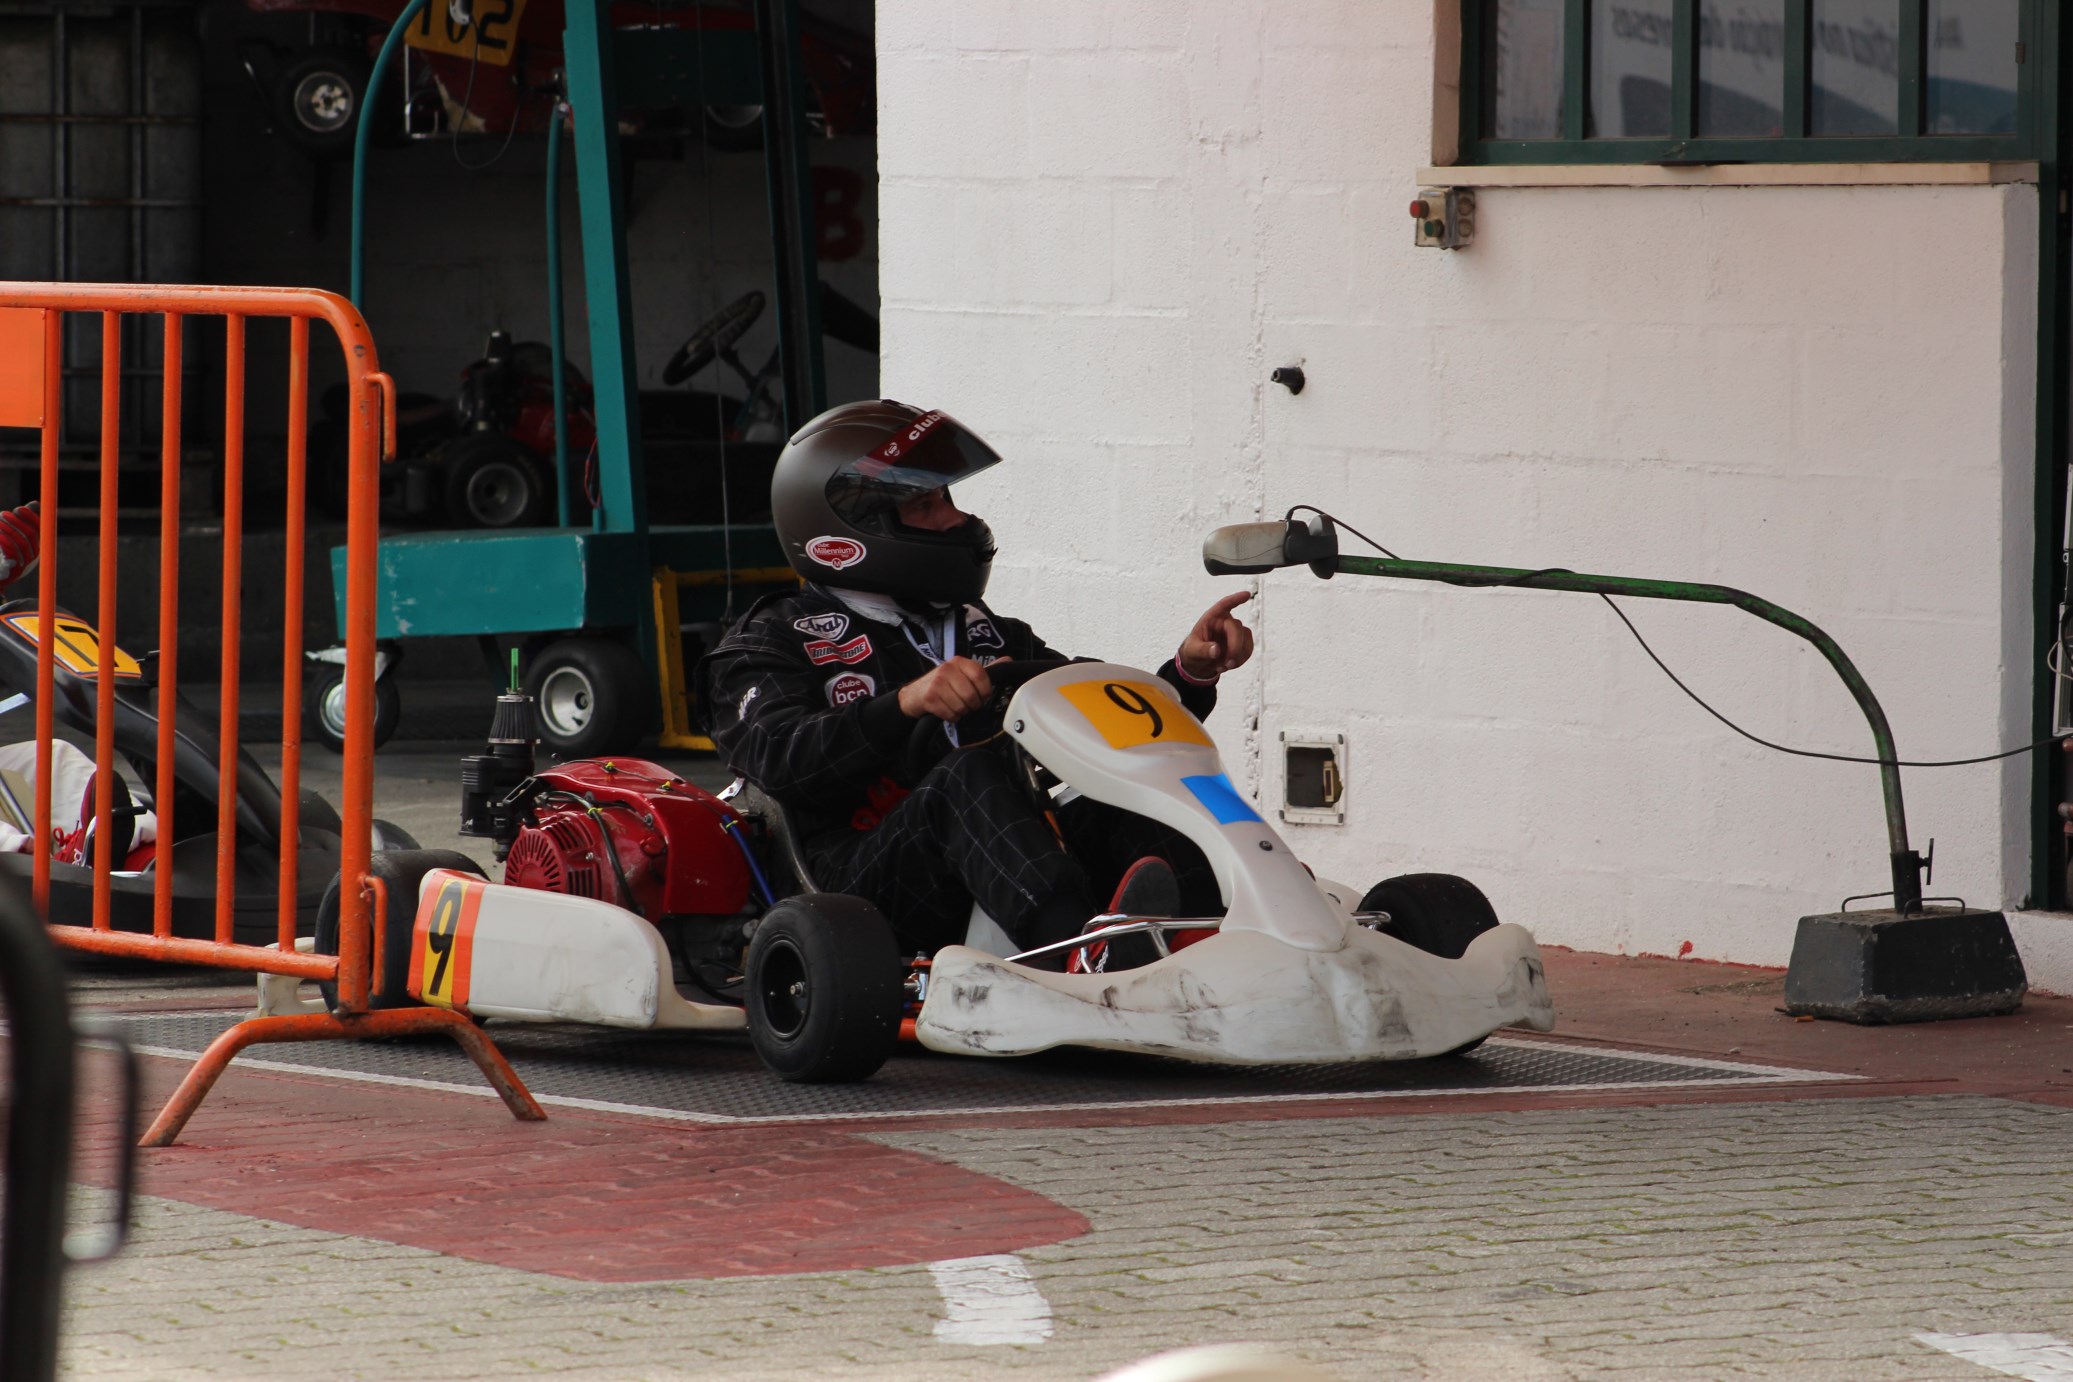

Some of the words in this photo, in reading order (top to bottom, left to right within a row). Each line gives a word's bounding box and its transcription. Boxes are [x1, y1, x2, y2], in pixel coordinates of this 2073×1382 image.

[814, 545, 854, 555] Millennium
[803, 615, 842, 632] Arai
[837, 680, 861, 689] clube
[1104, 683, 1163, 738] 9
[428, 881, 463, 996] 9
